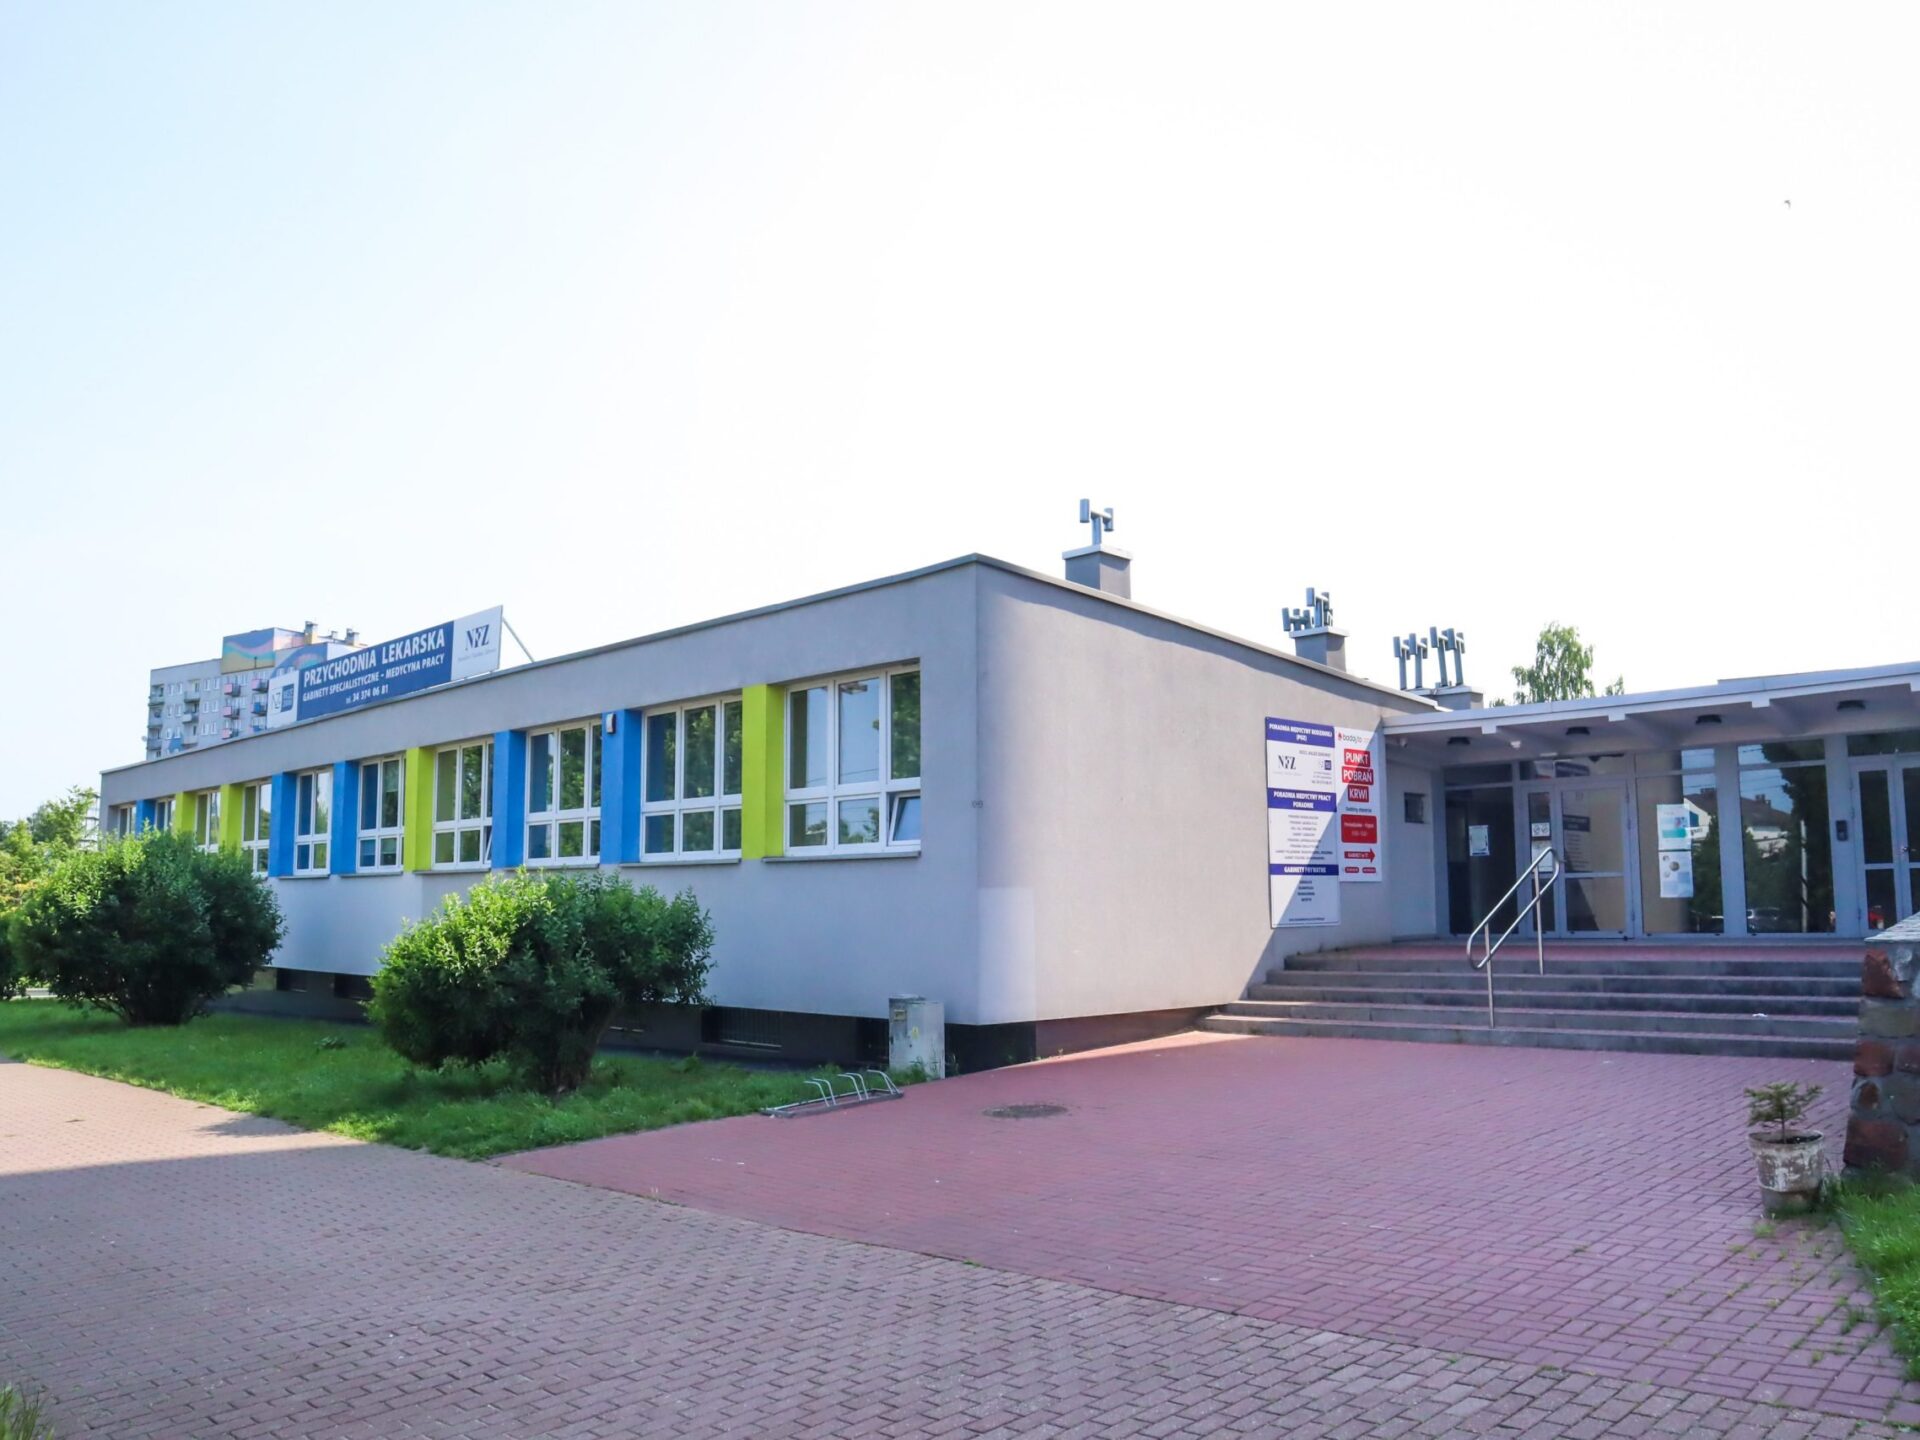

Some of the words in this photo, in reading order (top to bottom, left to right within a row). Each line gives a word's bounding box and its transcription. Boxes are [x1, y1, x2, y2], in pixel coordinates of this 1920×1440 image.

[465, 624, 490, 651] NFZ
[304, 649, 377, 687] PRZYCHODNIA
[382, 628, 445, 664] LEKARSKA
[303, 687, 328, 702] GABINETY
[329, 672, 379, 695] SPECJALISTYCZNE
[386, 662, 421, 678] MEDYCYNA
[422, 653, 445, 669] PRACY
[352, 693, 359, 702] 34
[1278, 754, 1296, 770] NFZ
[1345, 753, 1369, 765] PUNKT
[1343, 769, 1372, 782] POBRAŃ
[1349, 788, 1368, 800] KRWI
